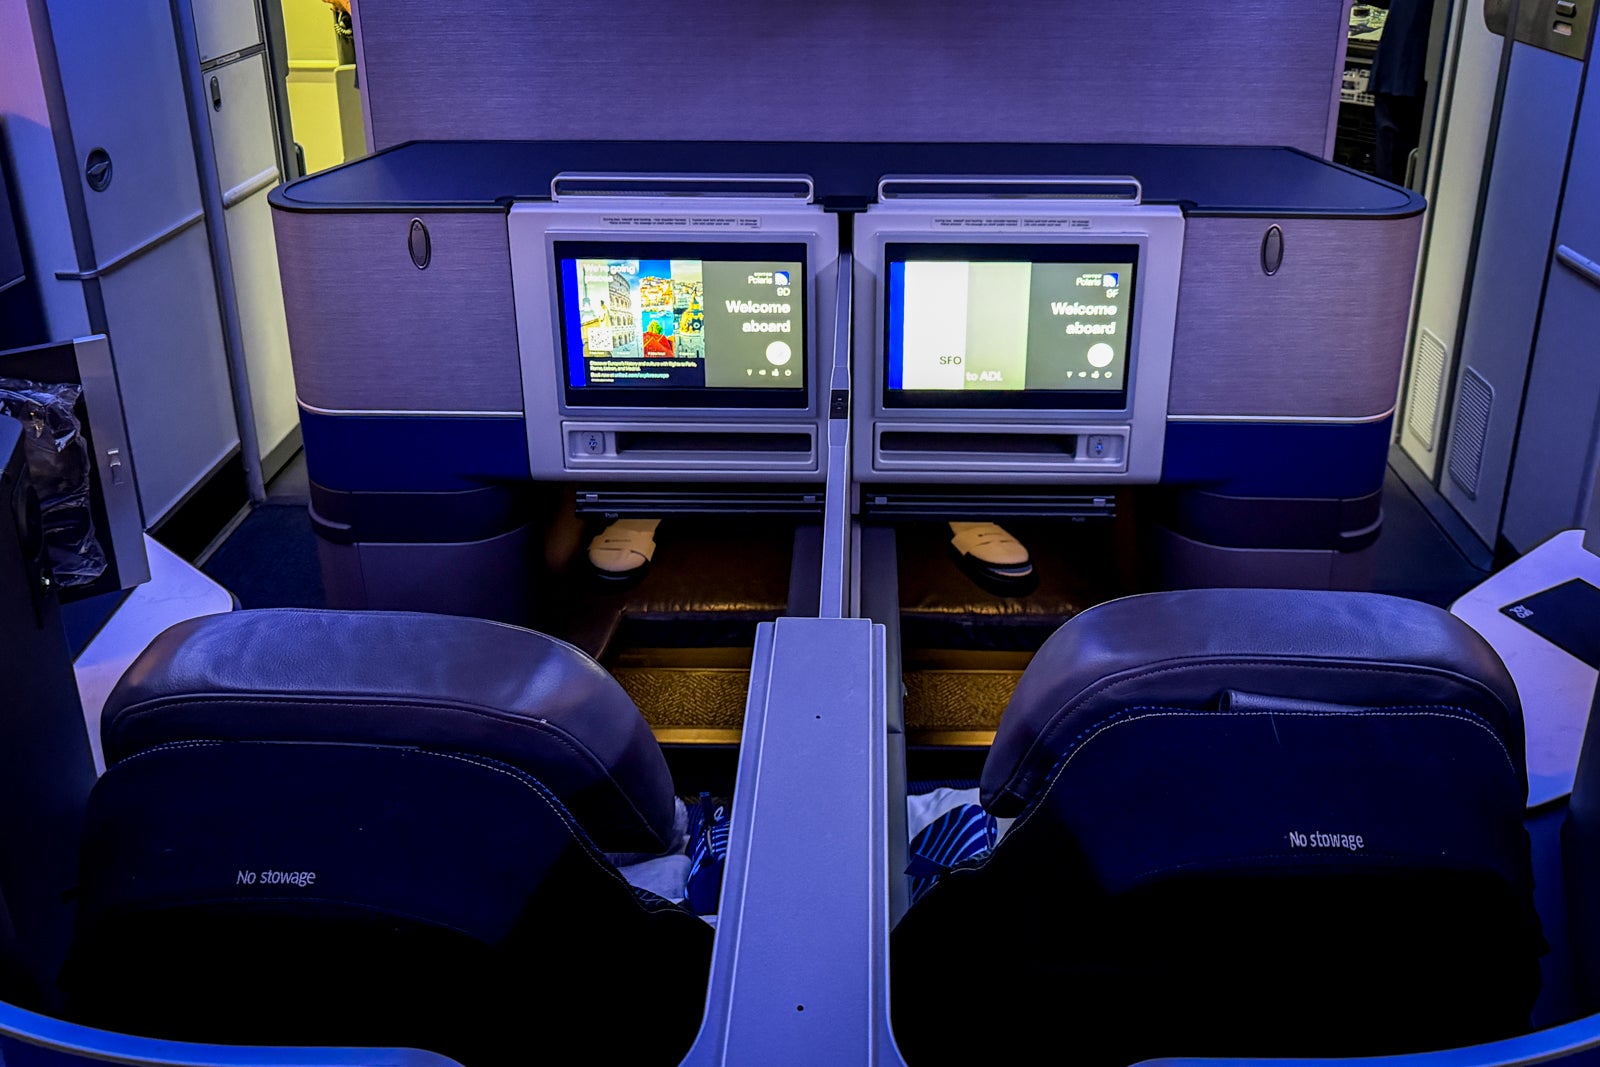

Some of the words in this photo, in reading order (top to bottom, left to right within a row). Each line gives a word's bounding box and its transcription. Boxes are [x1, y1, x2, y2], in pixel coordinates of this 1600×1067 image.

[610, 264, 636, 275] going
[777, 287, 791, 296] 9D
[1106, 289, 1119, 298] 9F
[725, 300, 791, 314] Welcome
[1051, 302, 1117, 316] Welcome
[742, 320, 791, 333] aboard
[1066, 321, 1116, 335] aboard
[939, 355, 962, 365] SFO
[966, 371, 978, 381] to
[980, 370, 1003, 381] ADL
[1289, 831, 1307, 848] No
[1310, 830, 1364, 851] stowage
[236, 870, 257, 884] No
[260, 869, 316, 887] stowage
